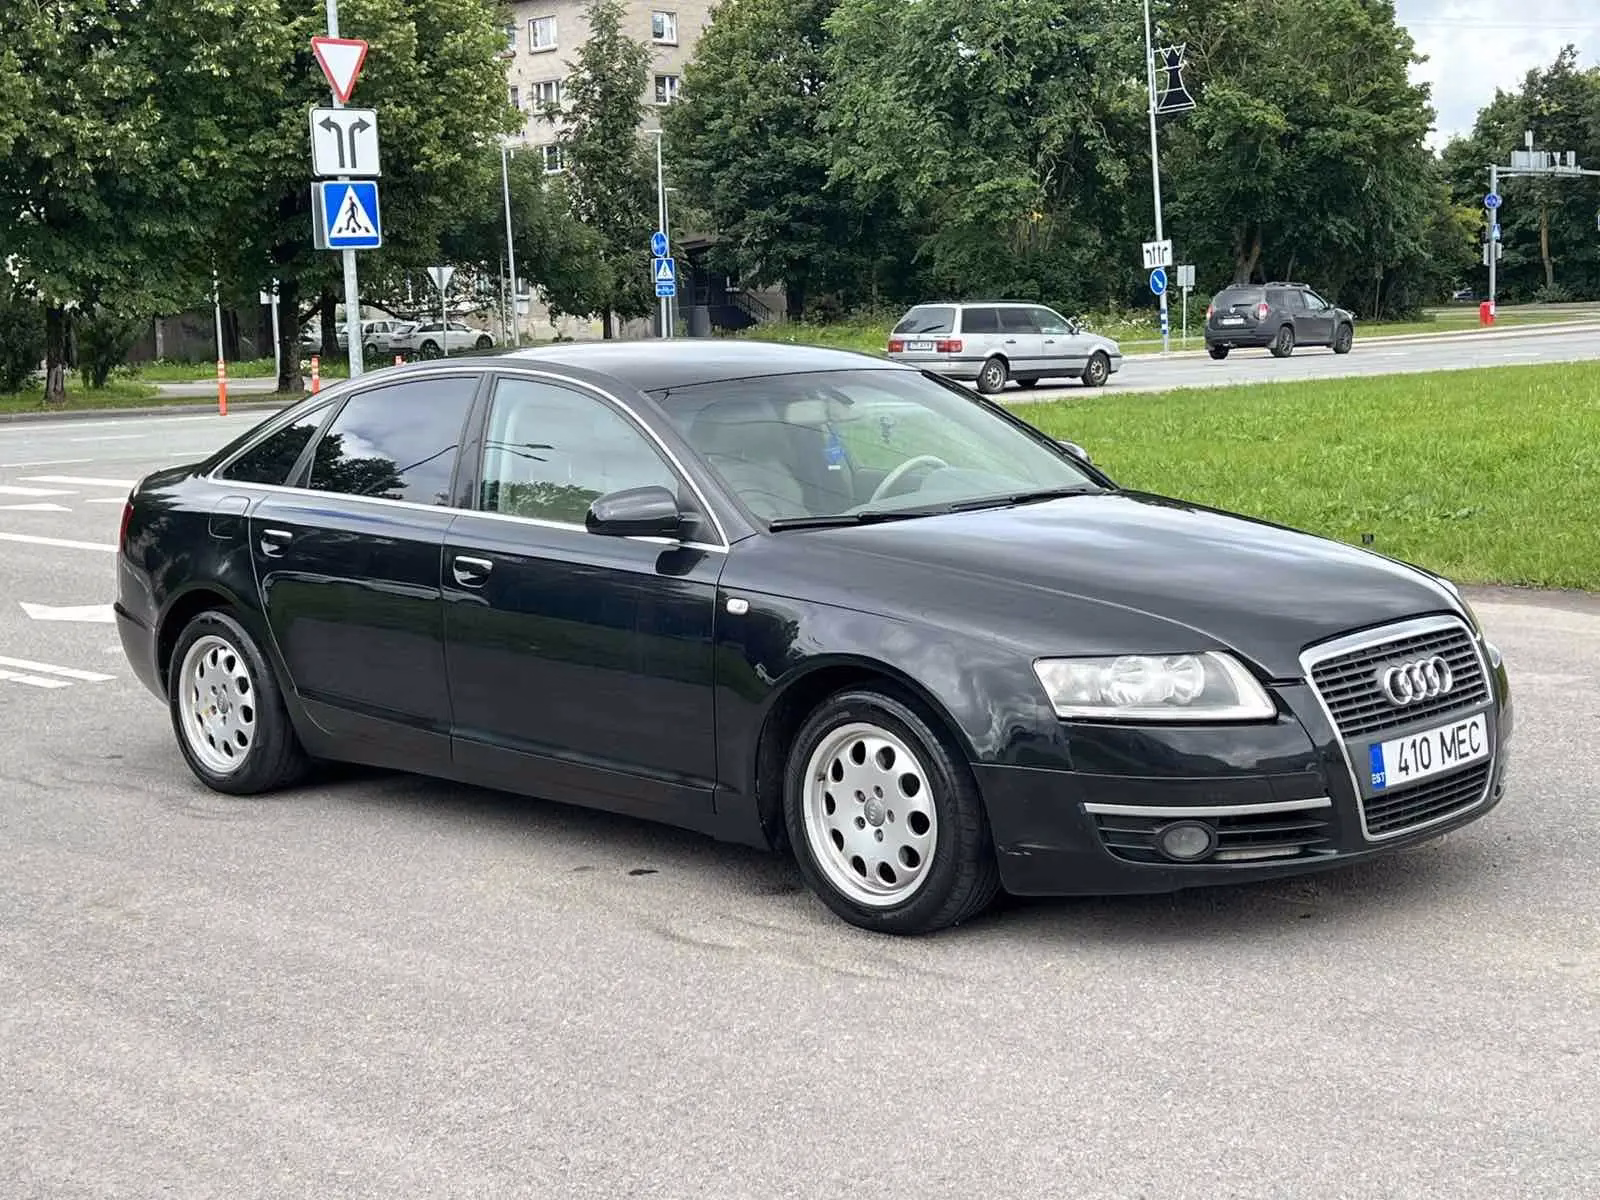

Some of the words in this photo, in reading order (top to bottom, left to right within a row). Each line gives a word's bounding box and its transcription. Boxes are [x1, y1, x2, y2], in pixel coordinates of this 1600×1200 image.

[1399, 736, 1432, 776] 410
[1440, 721, 1480, 765] MEC
[1371, 772, 1385, 785] EST
